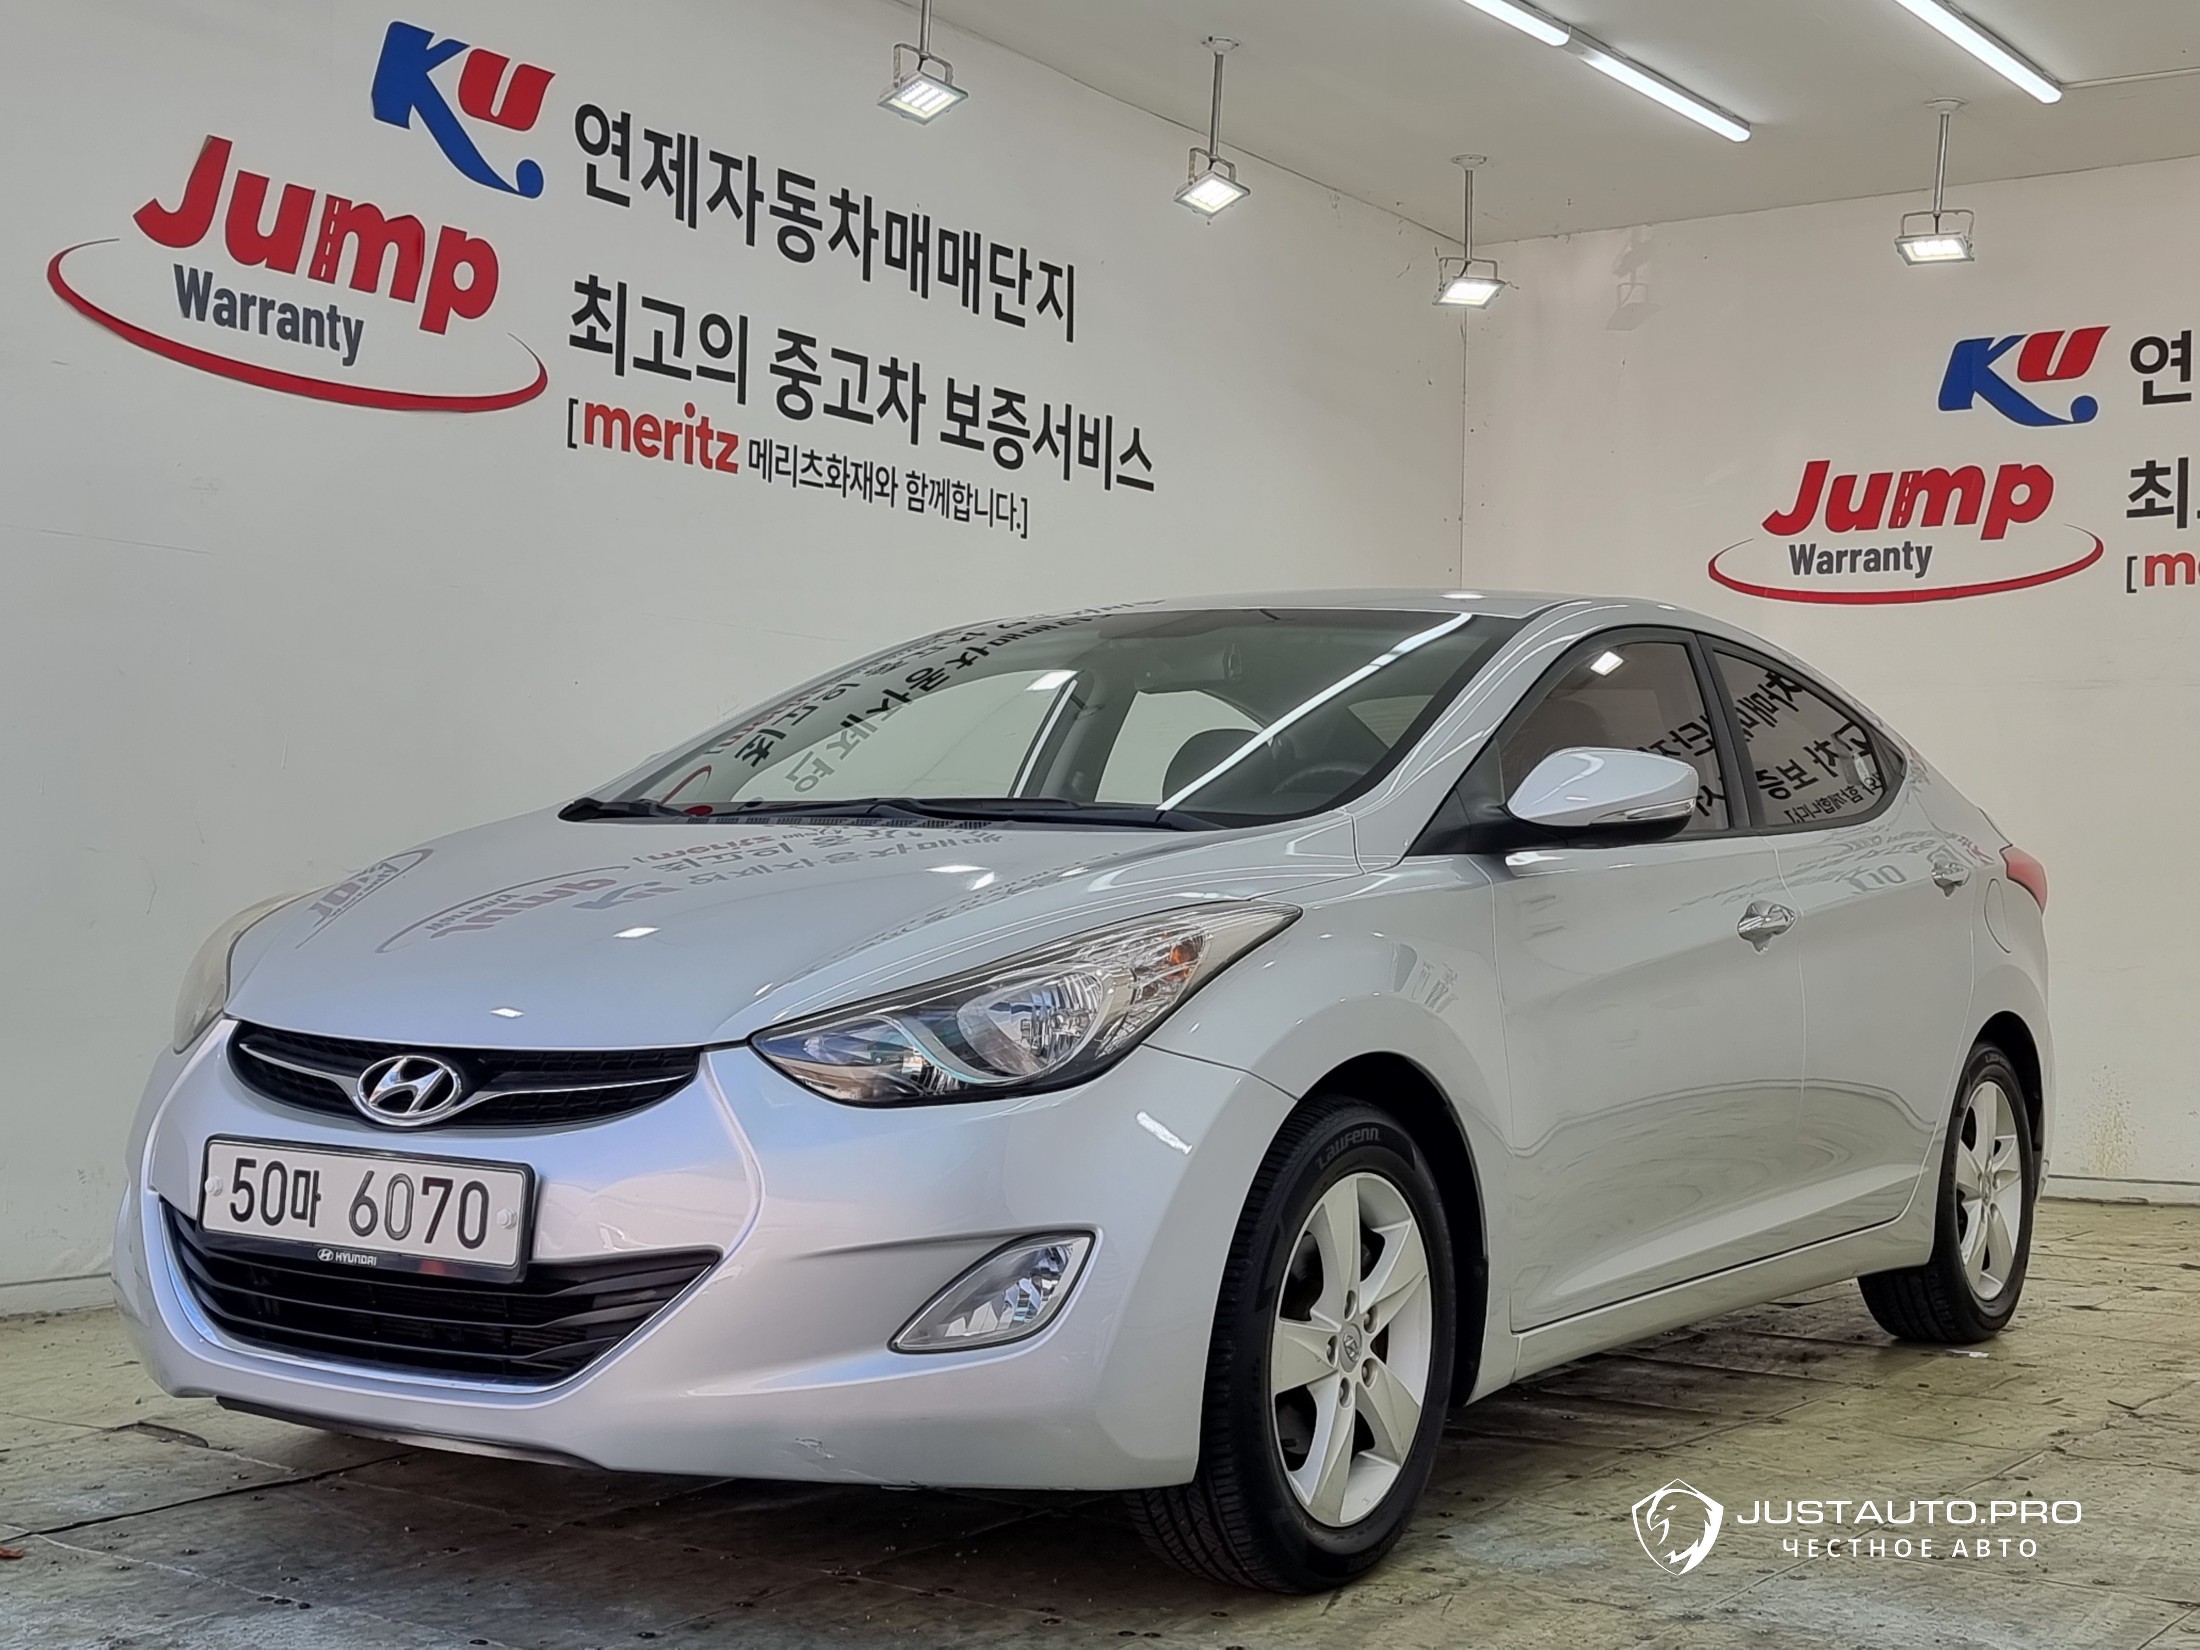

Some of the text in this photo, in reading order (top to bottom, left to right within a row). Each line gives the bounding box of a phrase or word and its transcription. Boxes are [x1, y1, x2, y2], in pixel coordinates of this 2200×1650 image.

[133, 134, 499, 335] Jump
[574, 103, 1077, 343] 연제자동차매매단지
[173, 264, 364, 366] Warranty
[568, 273, 1155, 492] 최고의 중고차 보증서비스
[748, 438, 899, 508] 메리츠화재와
[1762, 460, 2054, 540] Jump
[2126, 457, 2200, 529] 최
[1789, 540, 1933, 578] Warranty
[229, 1158, 487, 1249] 50마 6070
[335, 1251, 377, 1267] HYUNDAI
